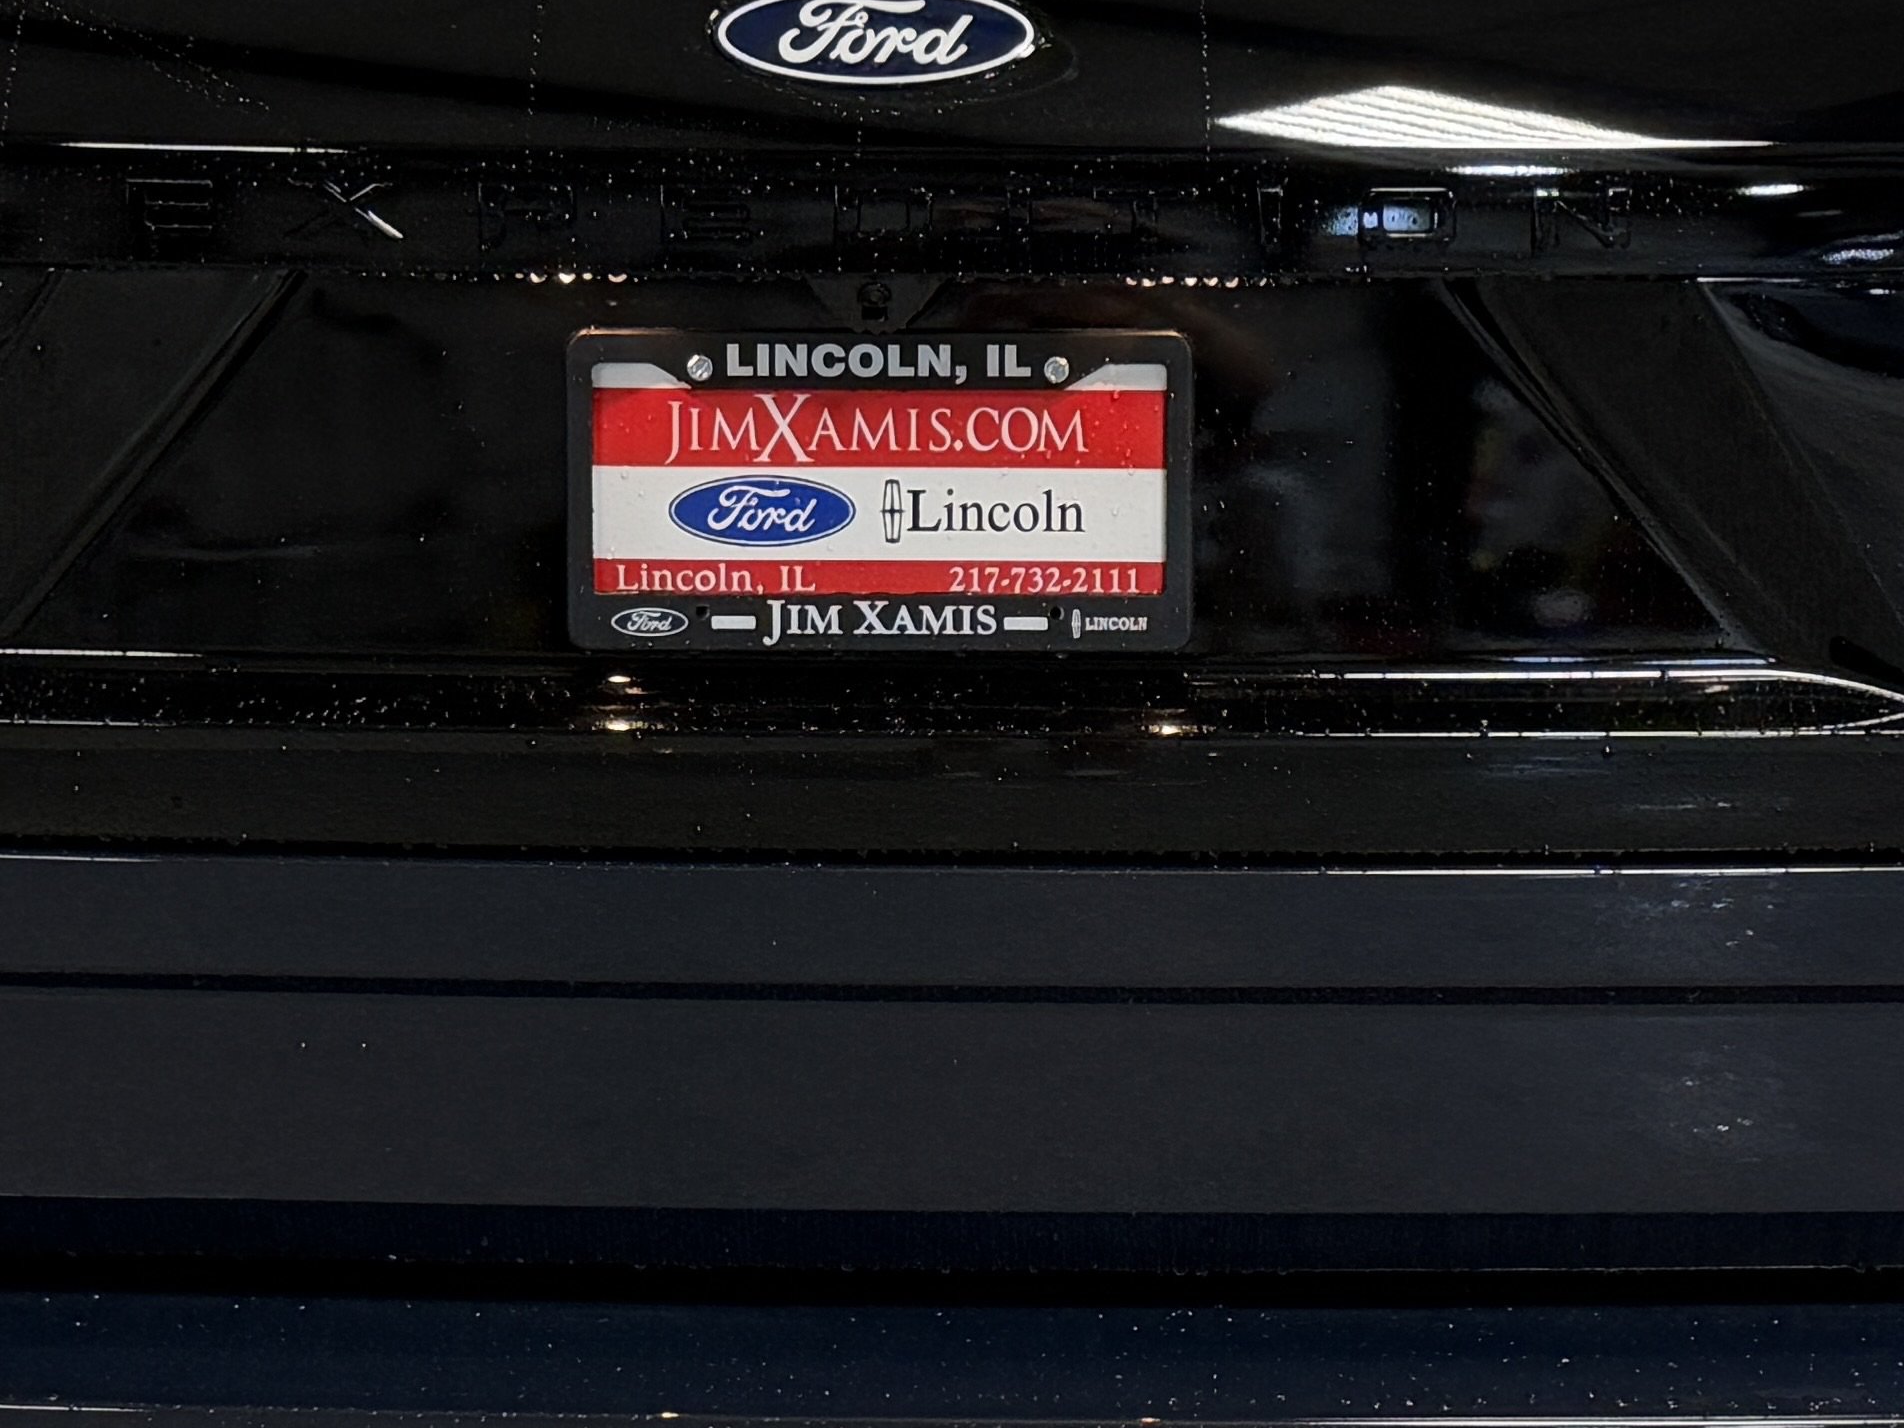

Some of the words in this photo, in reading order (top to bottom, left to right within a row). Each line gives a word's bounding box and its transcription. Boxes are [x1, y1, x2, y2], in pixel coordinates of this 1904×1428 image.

[726, 344, 967, 385] LINCOLN,
[986, 344, 1031, 377] IL
[707, 484, 817, 534] Ford
[907, 490, 1085, 533] Lincoln
[616, 564, 763, 595] Lincoln,
[780, 566, 817, 592] IL
[949, 567, 1139, 593] 217-732-2111
[626, 610, 672, 632] Ford
[1085, 616, 1148, 631] LINCOLN
